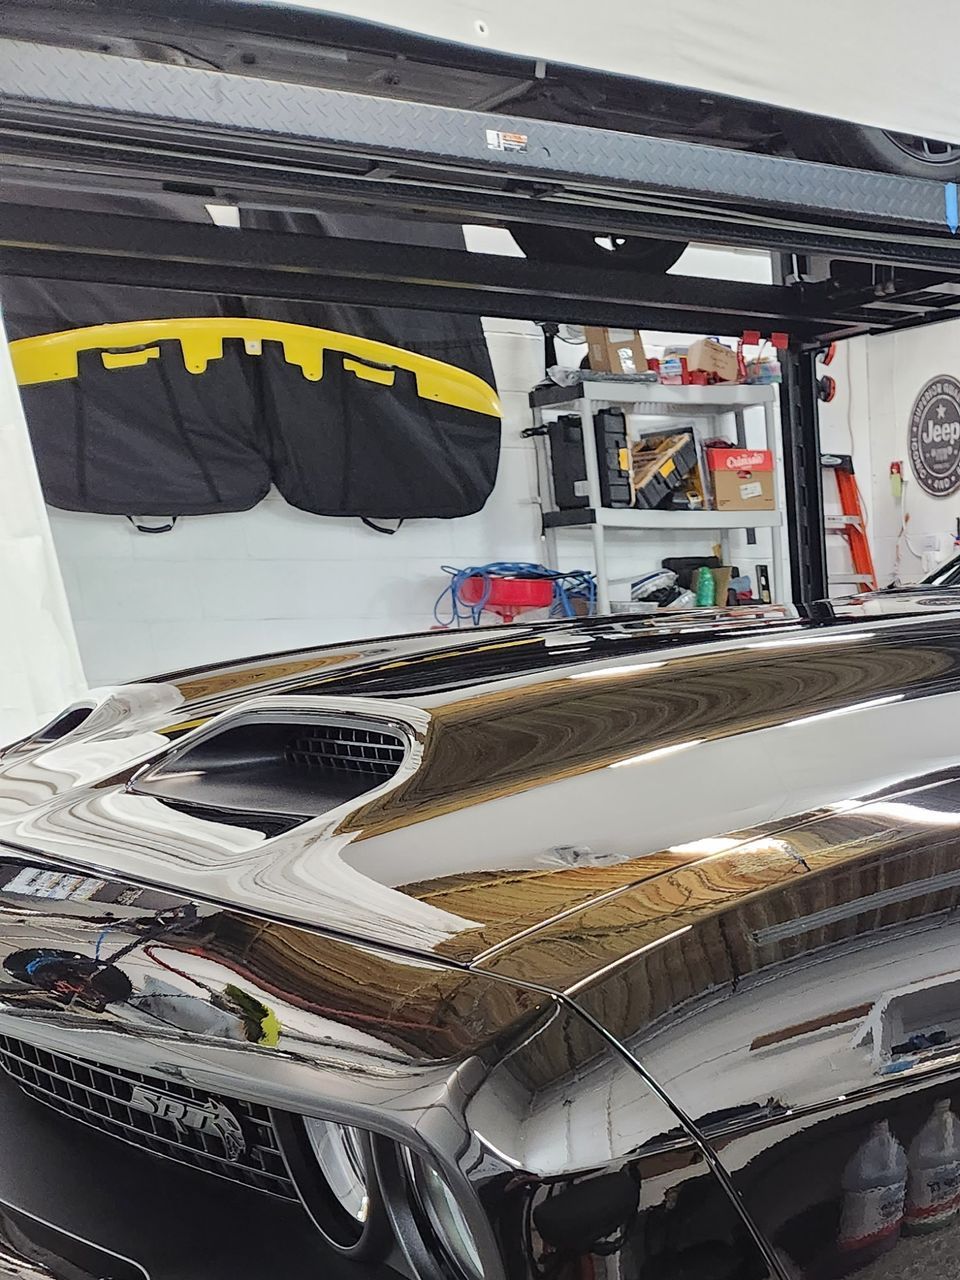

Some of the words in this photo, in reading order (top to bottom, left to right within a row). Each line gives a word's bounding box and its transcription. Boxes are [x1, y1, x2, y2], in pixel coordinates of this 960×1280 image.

[913, 383, 942, 422] SUPERIOR
[922, 420, 960, 445] Jeep
[911, 437, 927, 479] ICONIC
[130, 1086, 220, 1138] SRT
